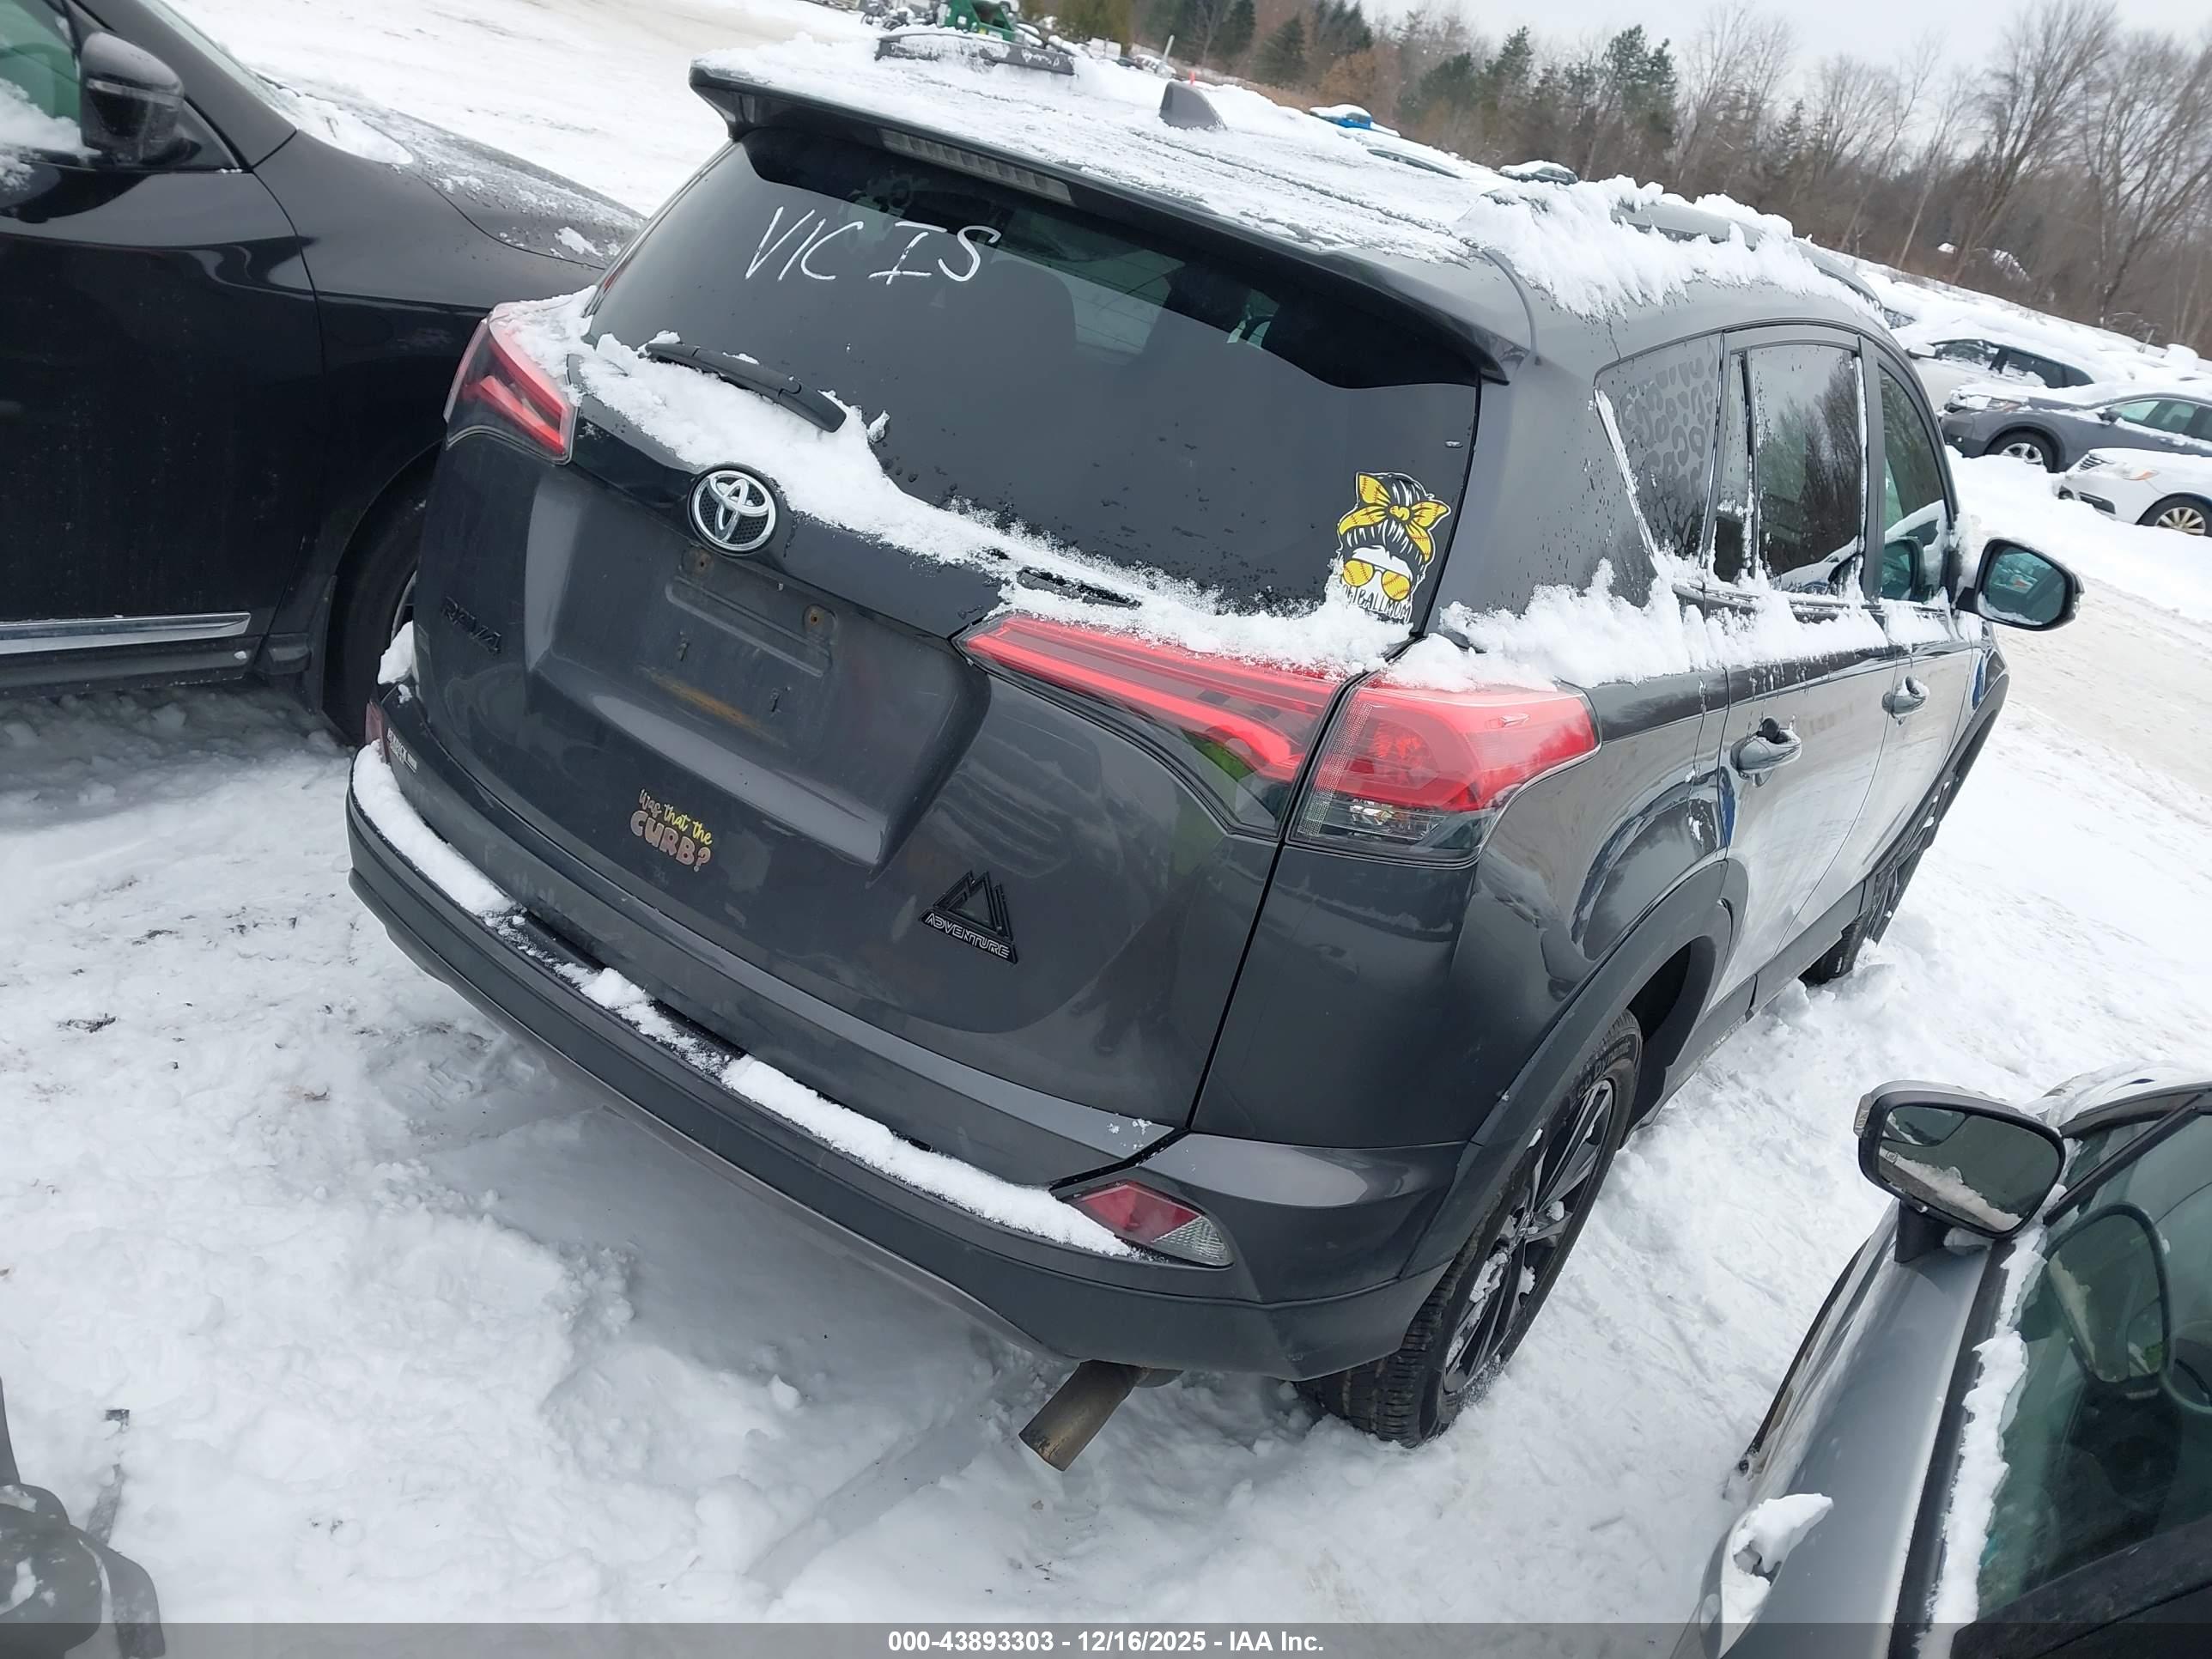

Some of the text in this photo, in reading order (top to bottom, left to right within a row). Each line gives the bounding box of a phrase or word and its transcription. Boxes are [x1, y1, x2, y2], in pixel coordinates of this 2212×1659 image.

[745, 206, 864, 281] VIC
[630, 810, 711, 872] CURB?
[639, 789, 713, 845] Was that the
[925, 912, 1010, 959] ADVENTURE
